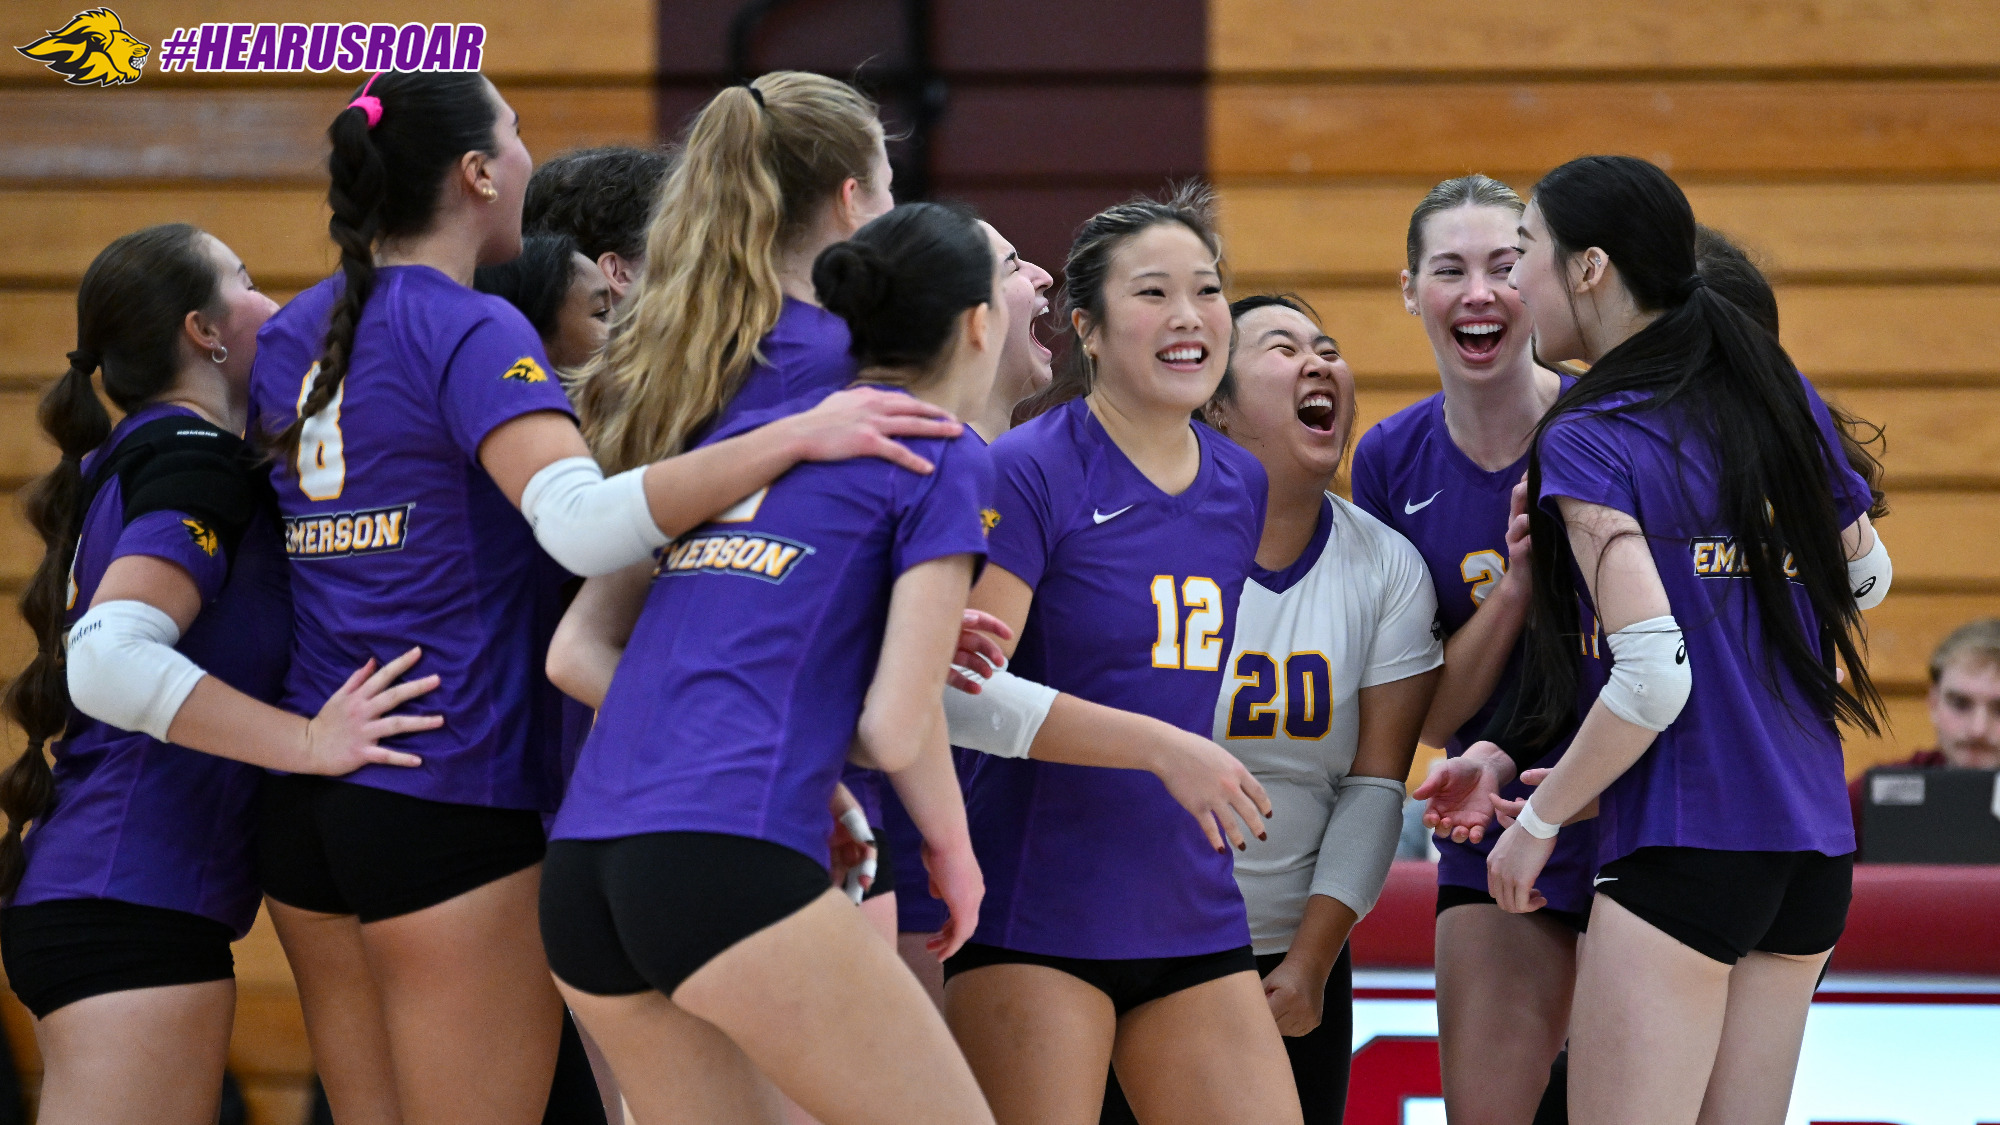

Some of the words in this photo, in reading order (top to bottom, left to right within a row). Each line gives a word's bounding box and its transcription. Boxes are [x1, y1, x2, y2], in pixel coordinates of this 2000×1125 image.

[1151, 575, 1223, 671] 12
[1460, 549, 1512, 608] 2
[1225, 650, 1333, 741] 20
